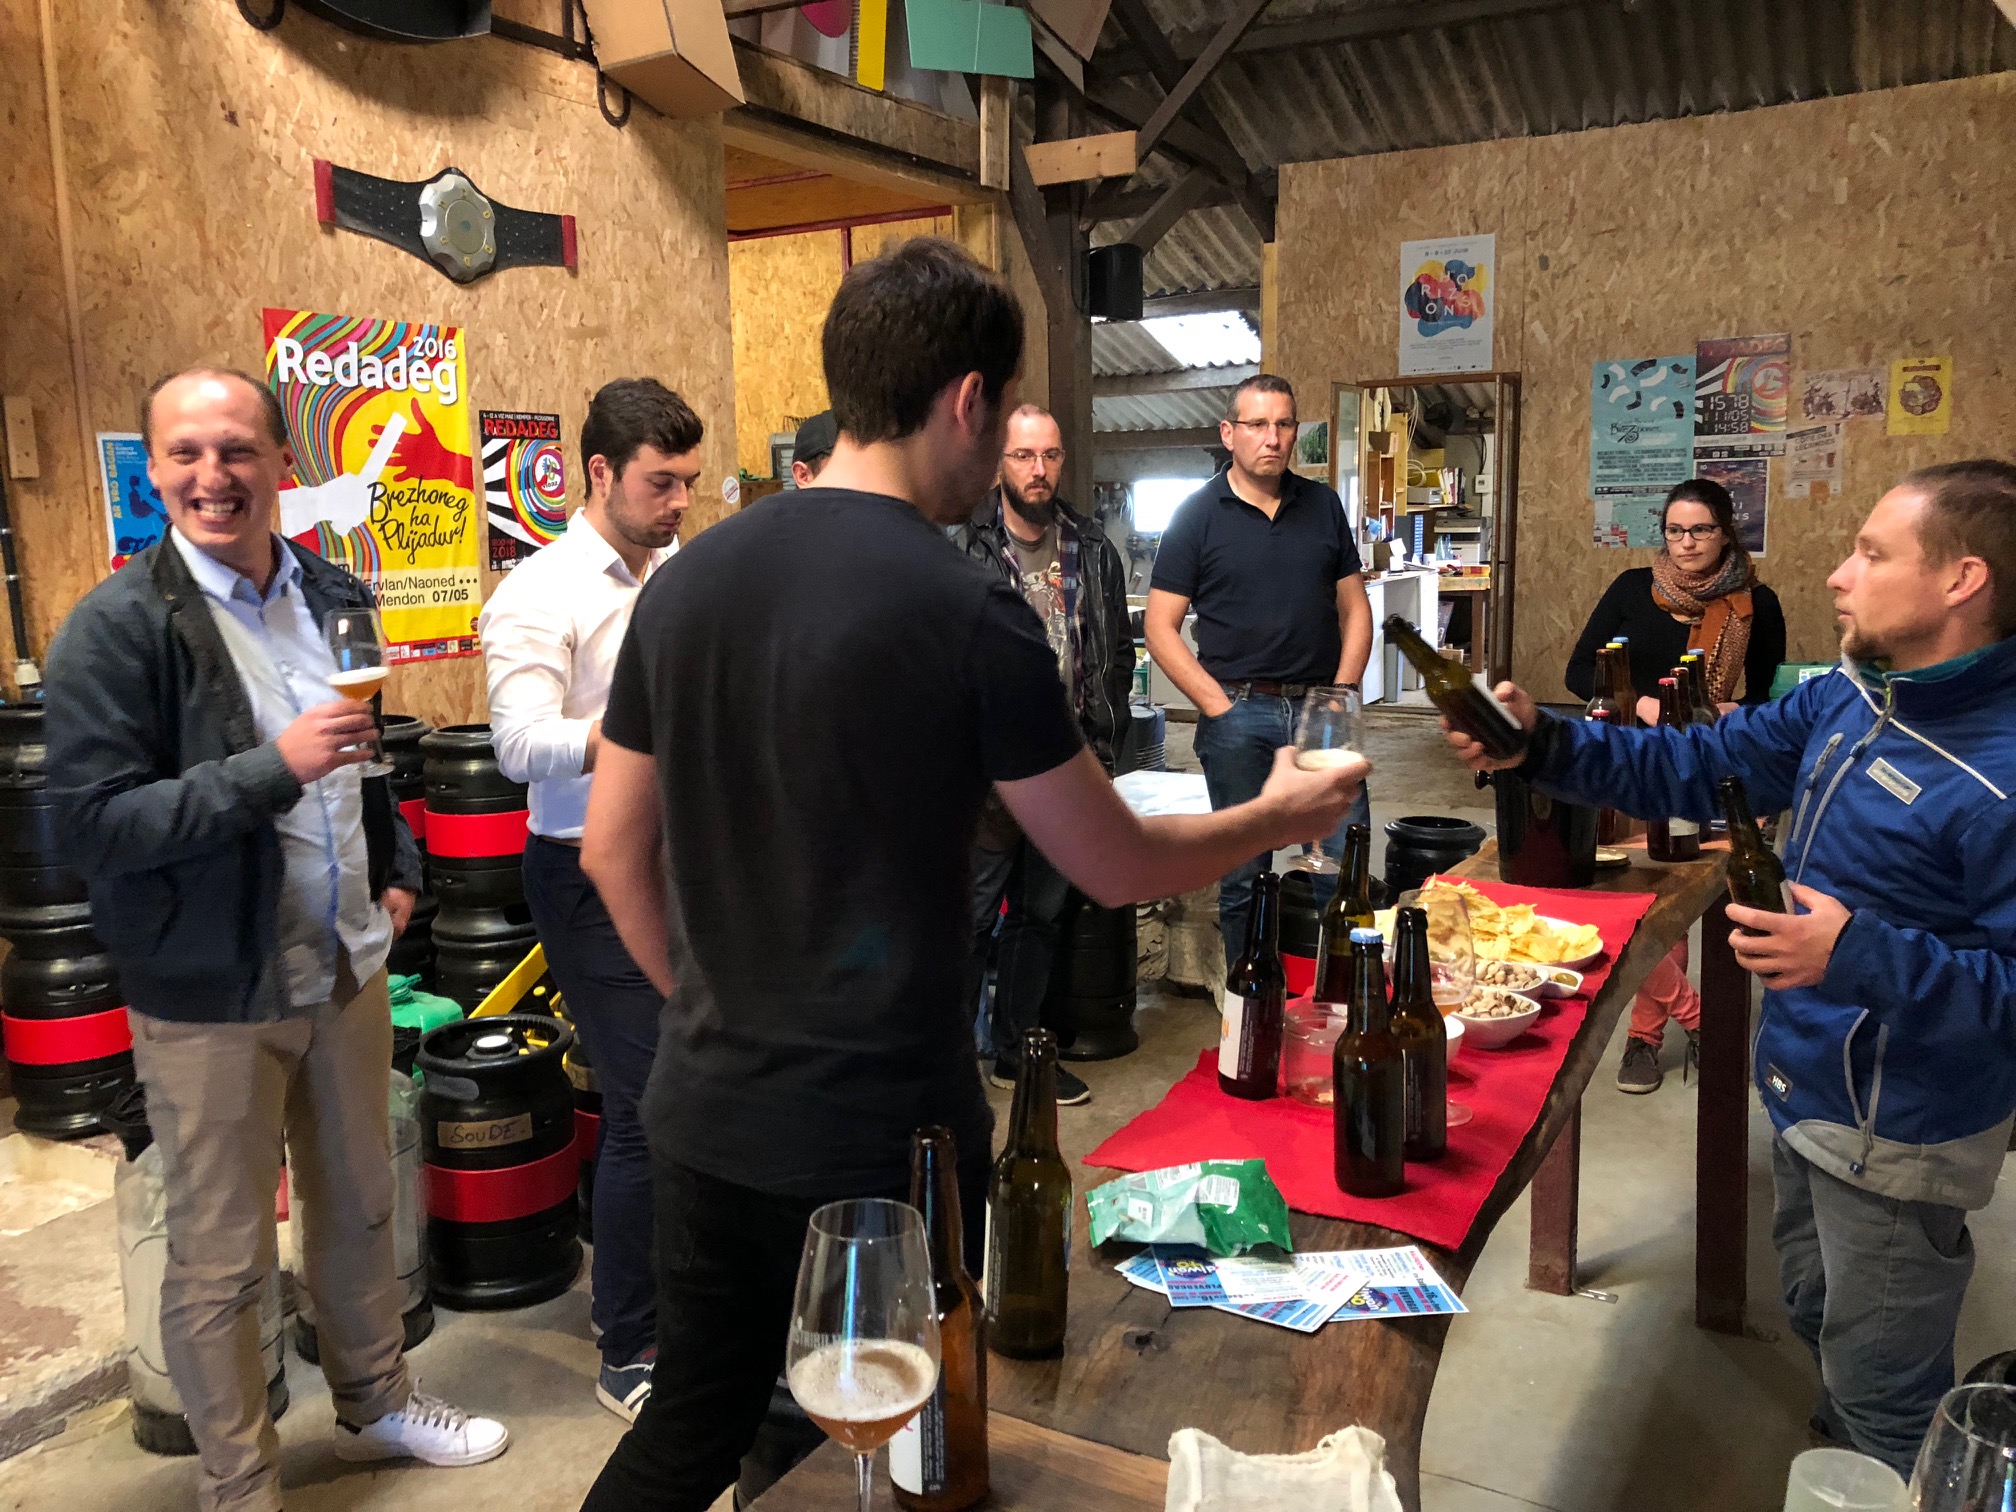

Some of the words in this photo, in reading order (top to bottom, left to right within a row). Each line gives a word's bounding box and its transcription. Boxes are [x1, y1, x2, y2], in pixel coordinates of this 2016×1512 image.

[412, 336, 457, 360] 2016
[274, 336, 458, 405] Redadeg
[484, 418, 557, 438] REDADEG
[1714, 421, 1749, 433] 14:58
[367, 475, 469, 525] Brezhoneg
[410, 505, 431, 527] ha
[378, 515, 466, 565] Plijadur!
[492, 546, 516, 558] 2018
[374, 593, 425, 607] Mendon
[432, 588, 468, 603] 07/05
[1168, 1265, 1216, 1276] diwan
